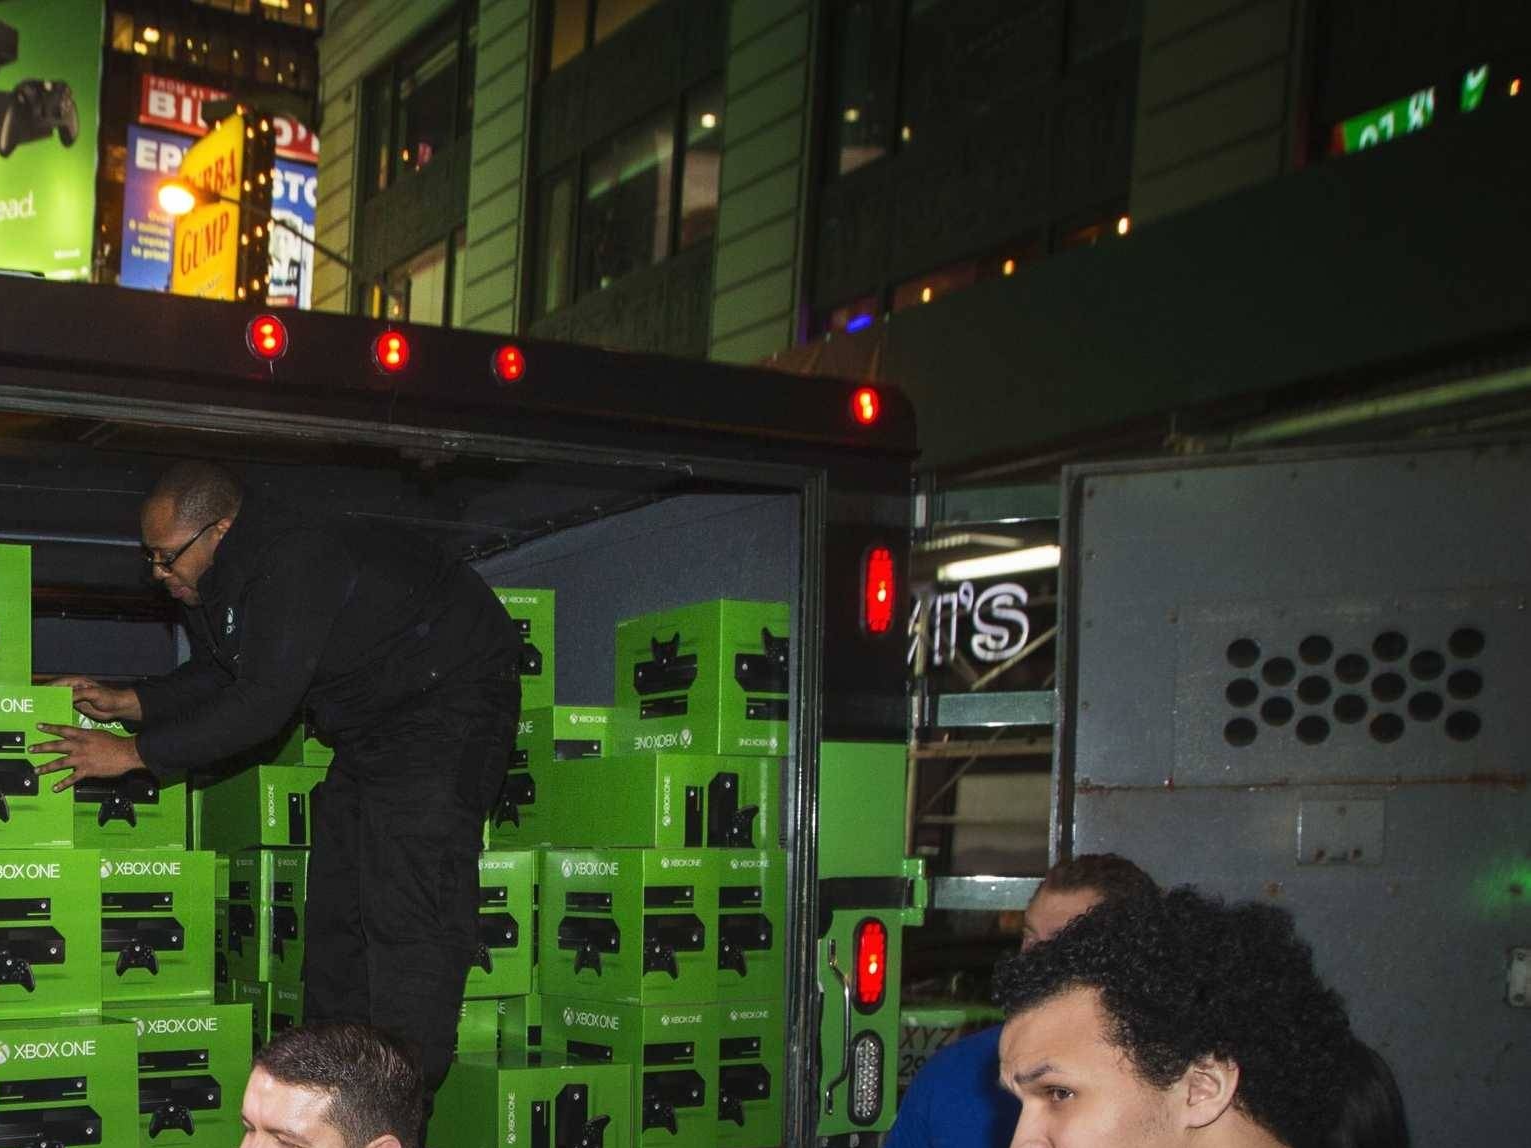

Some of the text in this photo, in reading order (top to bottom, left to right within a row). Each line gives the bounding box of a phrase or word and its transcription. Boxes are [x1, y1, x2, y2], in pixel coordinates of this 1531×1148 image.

[180, 211, 230, 277] GUMP
[2, 698, 34, 713] ONE
[634, 732, 678, 751] XBOX ONE
[25, 863, 60, 879] ONE
[115, 861, 181, 876] XBOX ONE
[573, 861, 619, 876] XBOX ONE
[147, 1017, 218, 1034] XBOX ONE
[575, 1011, 619, 1031] XBOX ONE
[13, 1040, 96, 1060] XBOX ONE
[508, 1093, 516, 1132] XBOX ONE
